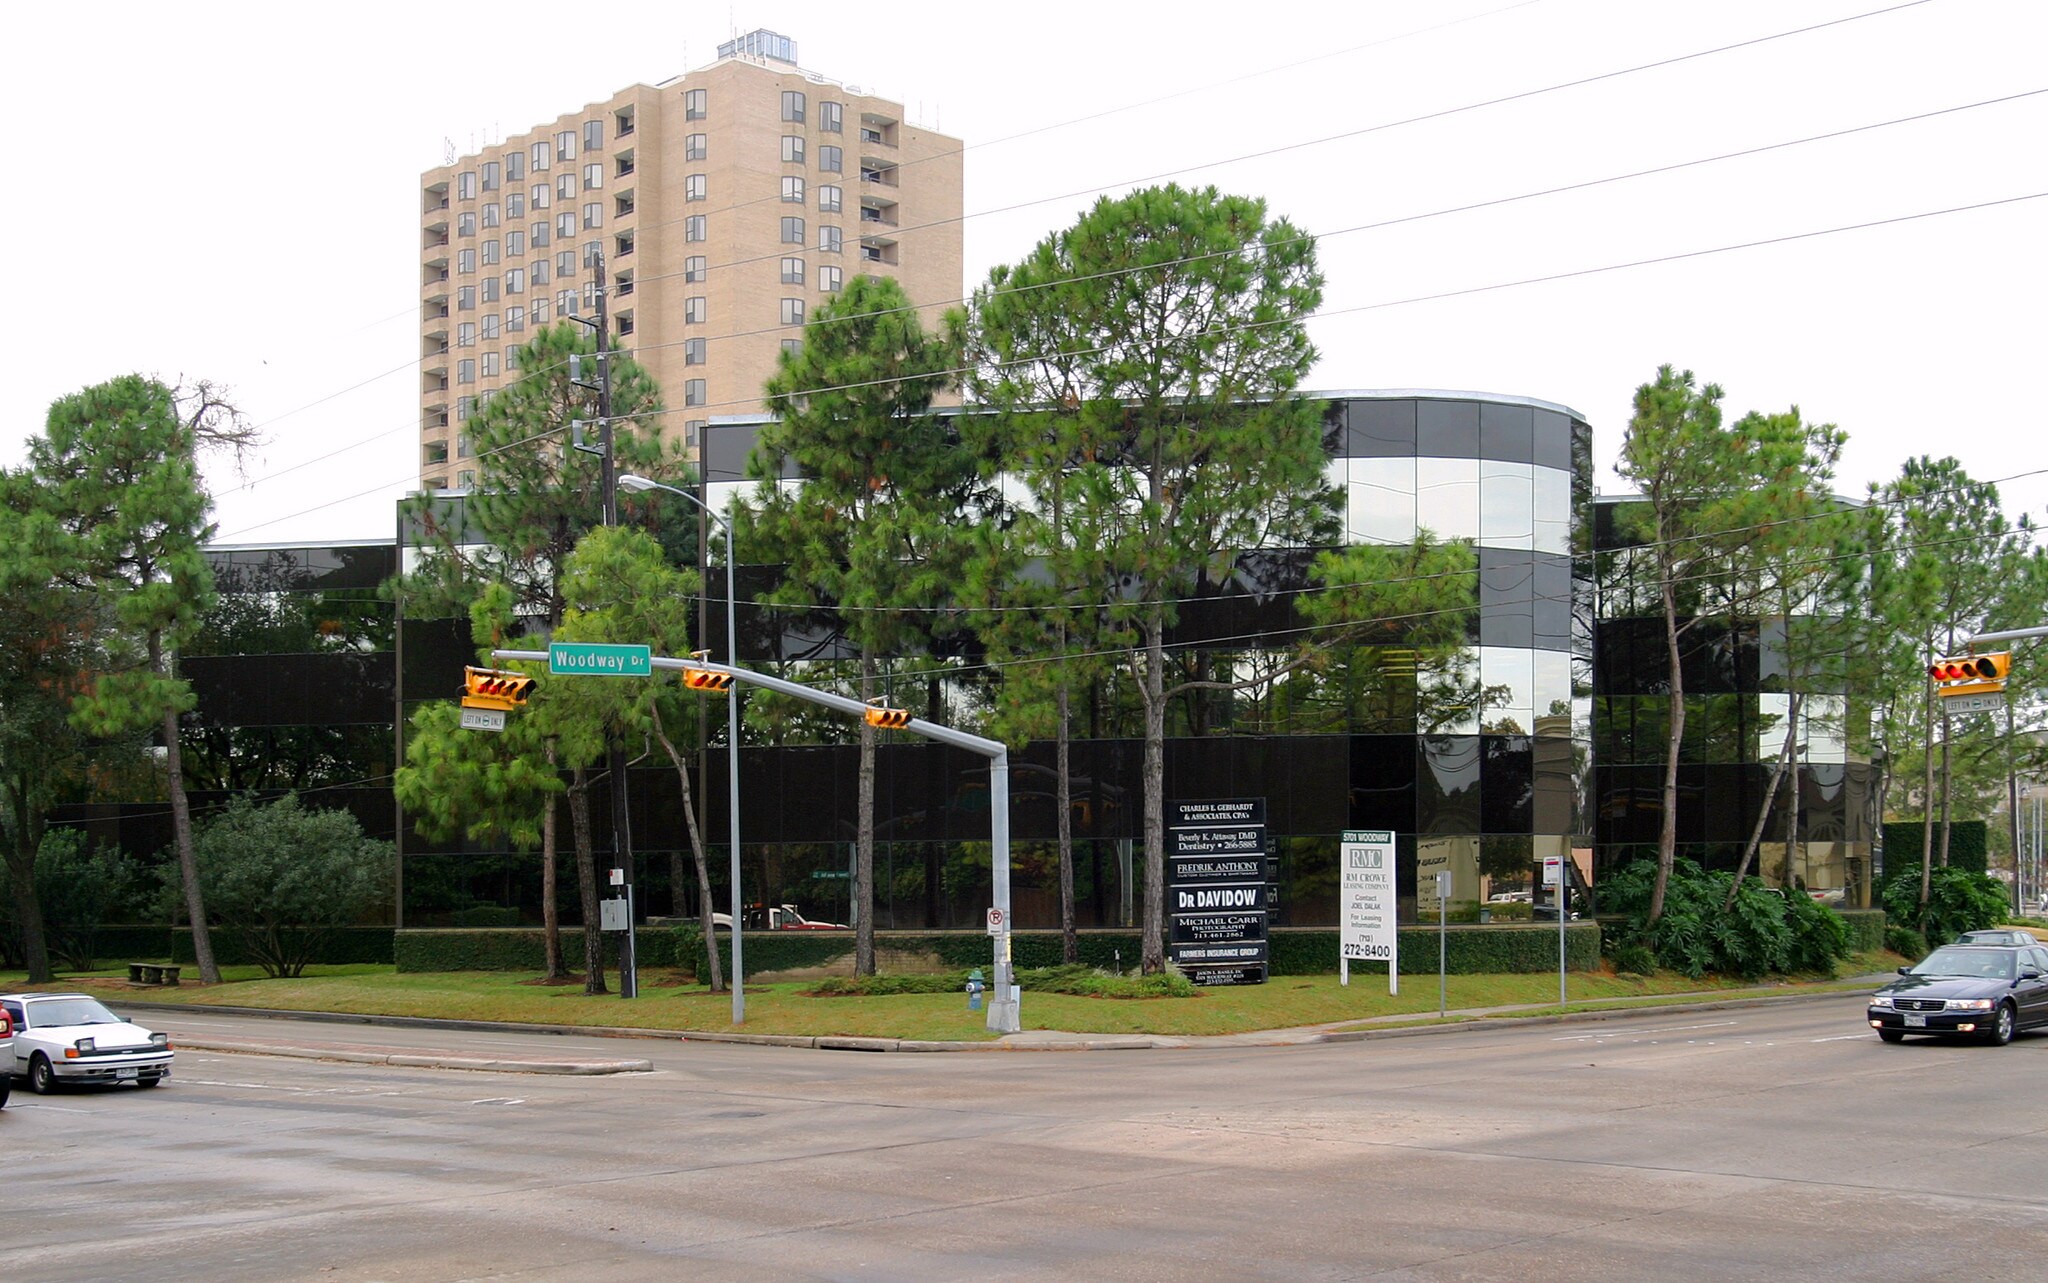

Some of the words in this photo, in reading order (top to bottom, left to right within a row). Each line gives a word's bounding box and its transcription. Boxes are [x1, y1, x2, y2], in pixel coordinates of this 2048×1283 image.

[556, 651, 624, 671] Woodway
[631, 655, 644, 666] Dr
[464, 714, 474, 724] LEFT
[1179, 804, 1210, 813] CHARLES
[1217, 803, 1254, 811] GEBHARDT
[1178, 833, 1201, 843] Beverly
[1238, 831, 1257, 840] DMD
[1357, 833, 1389, 842] WOODWAY
[1178, 842, 1216, 852] Dentistry
[1351, 849, 1381, 868] RMC
[1177, 863, 1214, 873] FREDRIK
[1216, 861, 1258, 871] ANTHONY
[1346, 873, 1358, 882] RM
[1360, 873, 1387, 883] CROWE
[1197, 889, 1257, 908] DAVIDOW
[1179, 917, 1227, 926] MICHAEL
[1227, 916, 1258, 924] CARR
[1361, 914, 1382, 922] Leasing
[1206, 948, 1238, 957] INSURANCE
[1239, 948, 1259, 956] GROUP
[1344, 943, 1390, 957] 272-8400
